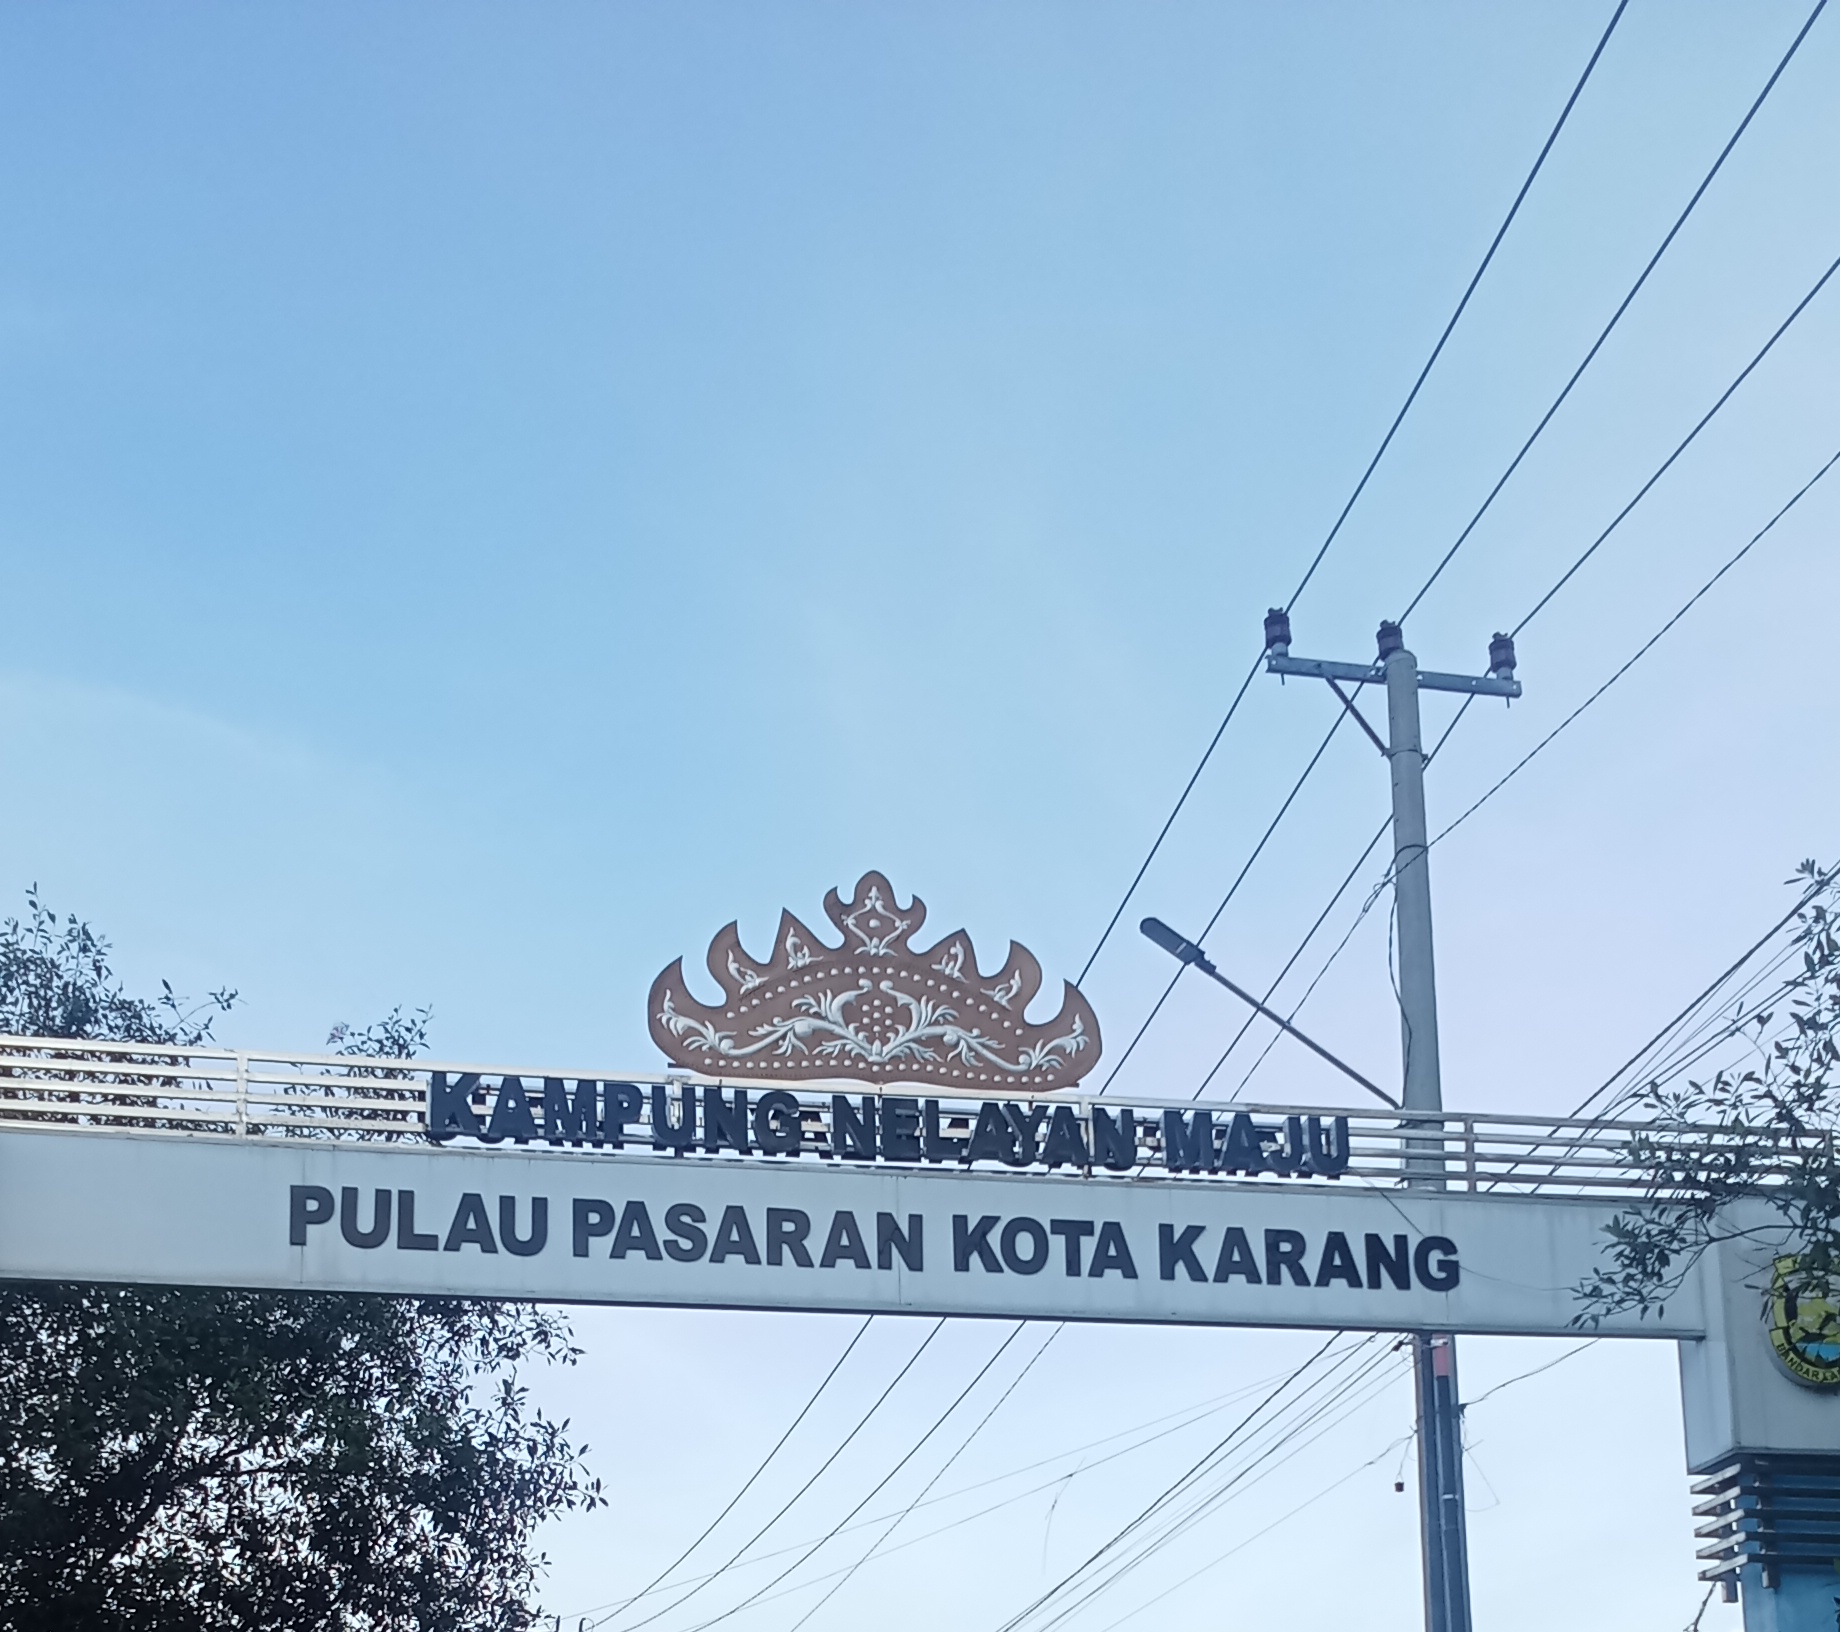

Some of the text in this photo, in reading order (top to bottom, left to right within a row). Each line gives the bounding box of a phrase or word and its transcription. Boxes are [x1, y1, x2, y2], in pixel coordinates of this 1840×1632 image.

[428, 1071, 1349, 1178] KAMPUNG NELAYAN MAJU
[289, 1184, 1461, 1292] PULAU PASARAN KOTA KARANG
[1777, 1343, 1820, 1380] BANDAR
